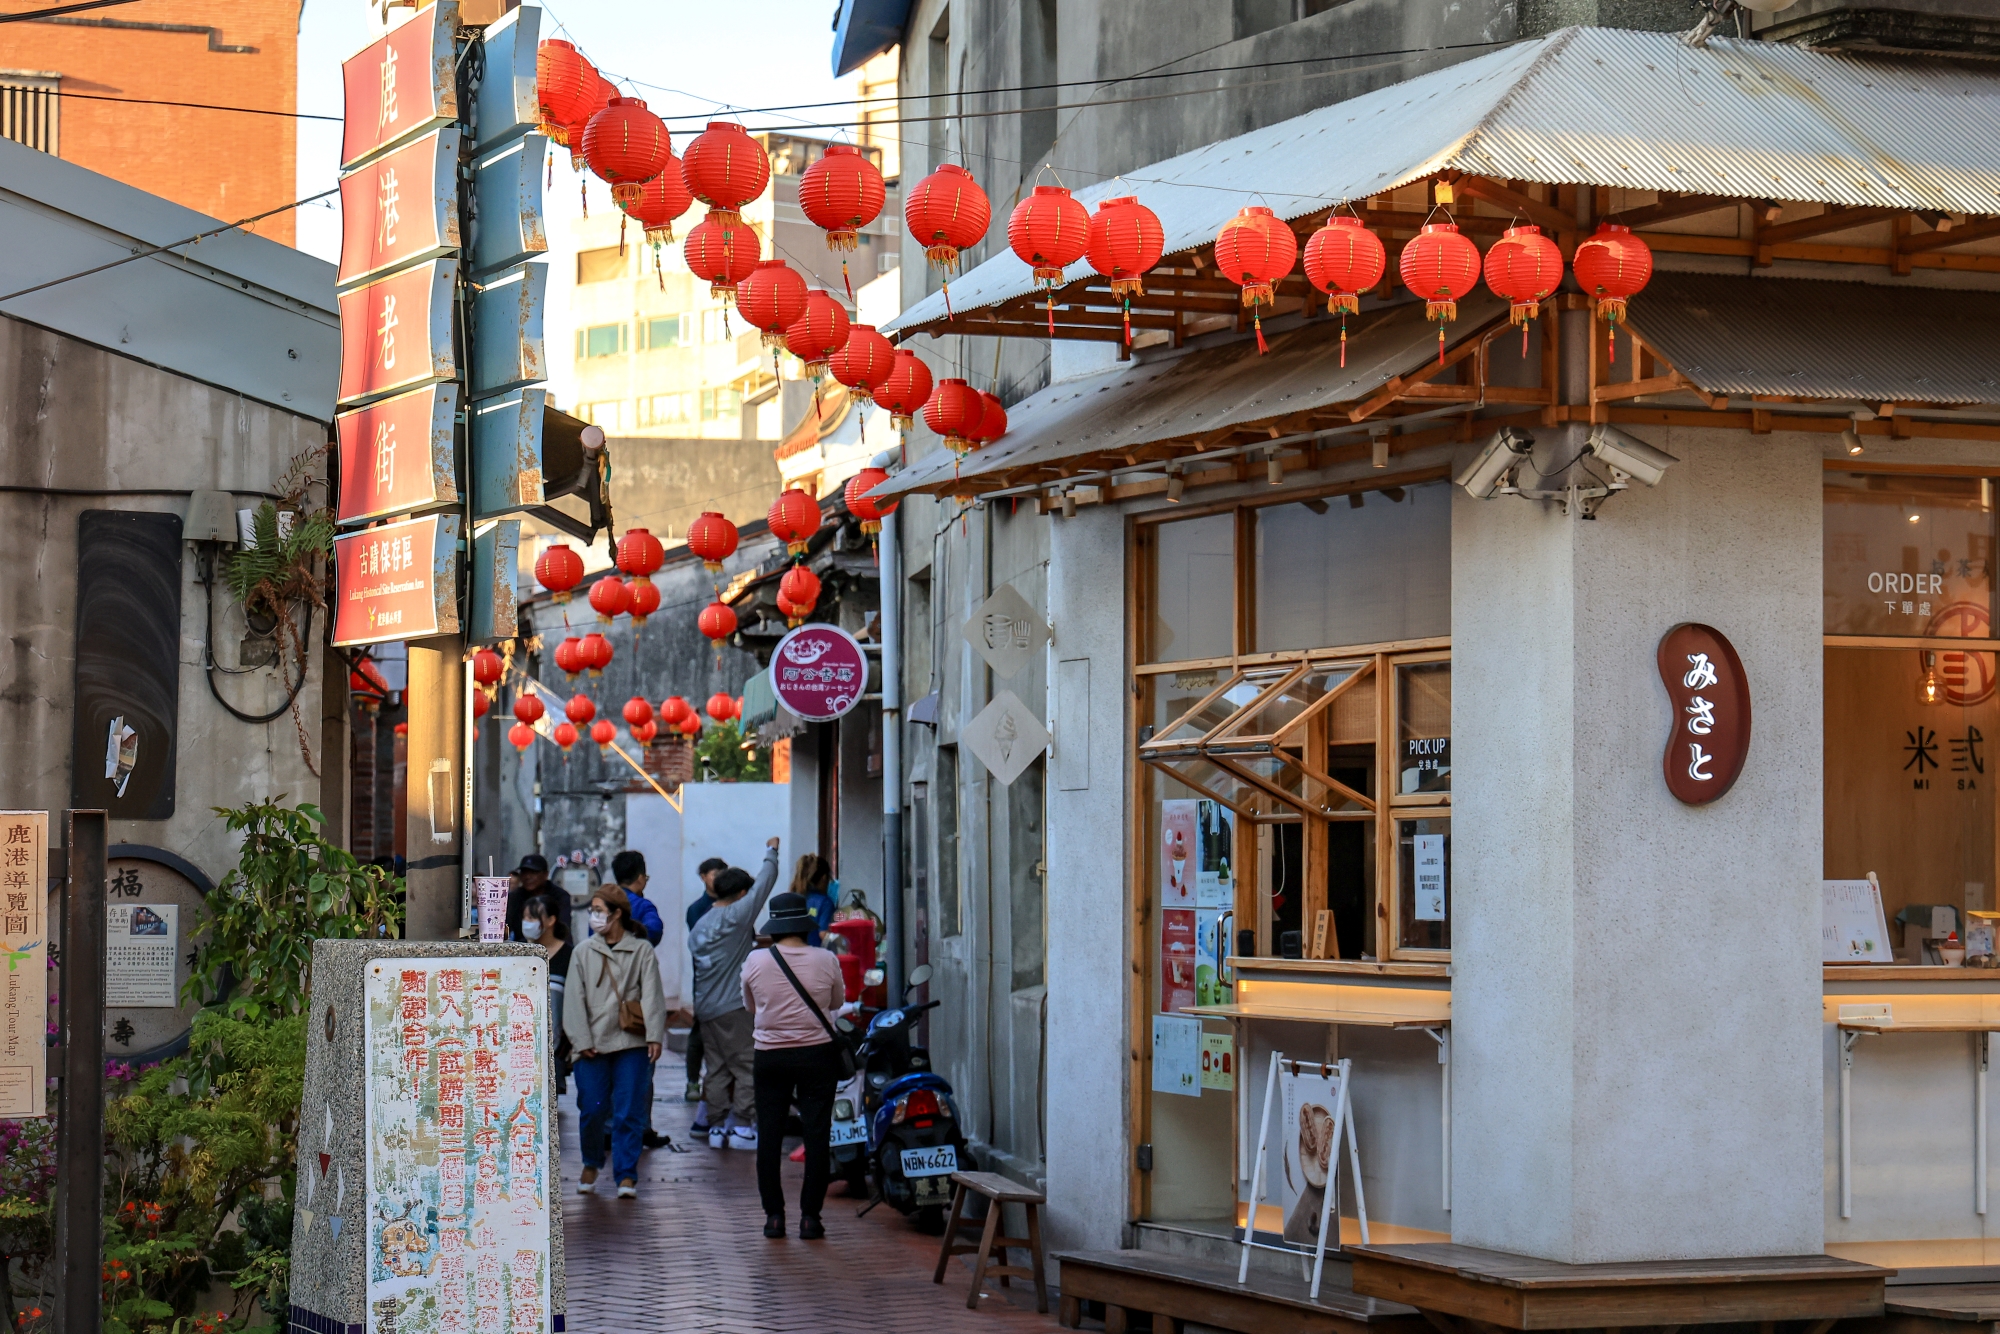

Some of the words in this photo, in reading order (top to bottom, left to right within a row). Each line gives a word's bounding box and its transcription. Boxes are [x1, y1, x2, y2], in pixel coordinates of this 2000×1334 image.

[373, 45, 399, 497] 鹿港老街
[359, 535, 413, 578] 古蹟保存區
[349, 588, 364, 602] Lukang
[363, 583, 382, 598] Historical
[382, 583, 390, 595] Site
[390, 581, 414, 594] Reservation
[414, 578, 424, 590] Area
[1867, 572, 1943, 595] ORDER
[1884, 601, 1931, 617] 下單處
[783, 667, 855, 682] 阿公香腸
[1683, 652, 1718, 782] みさと
[1409, 739, 1431, 755] PICK
[1432, 738, 1446, 754] UP
[1418, 758, 1438, 771] 兌換處
[1913, 779, 1930, 790] MI
[1957, 779, 1976, 791] SA
[3, 825, 31, 935] 鹿港導覽圖
[109, 868, 143, 898] 福
[109, 908, 128, 918] 存區
[5, 974, 20, 1009] Lukang
[8, 1010, 19, 1034] Tour
[110, 1016, 136, 1048] 壽
[5, 1035, 19, 1057] Map
[904, 1152, 955, 1171] NBN-6622
